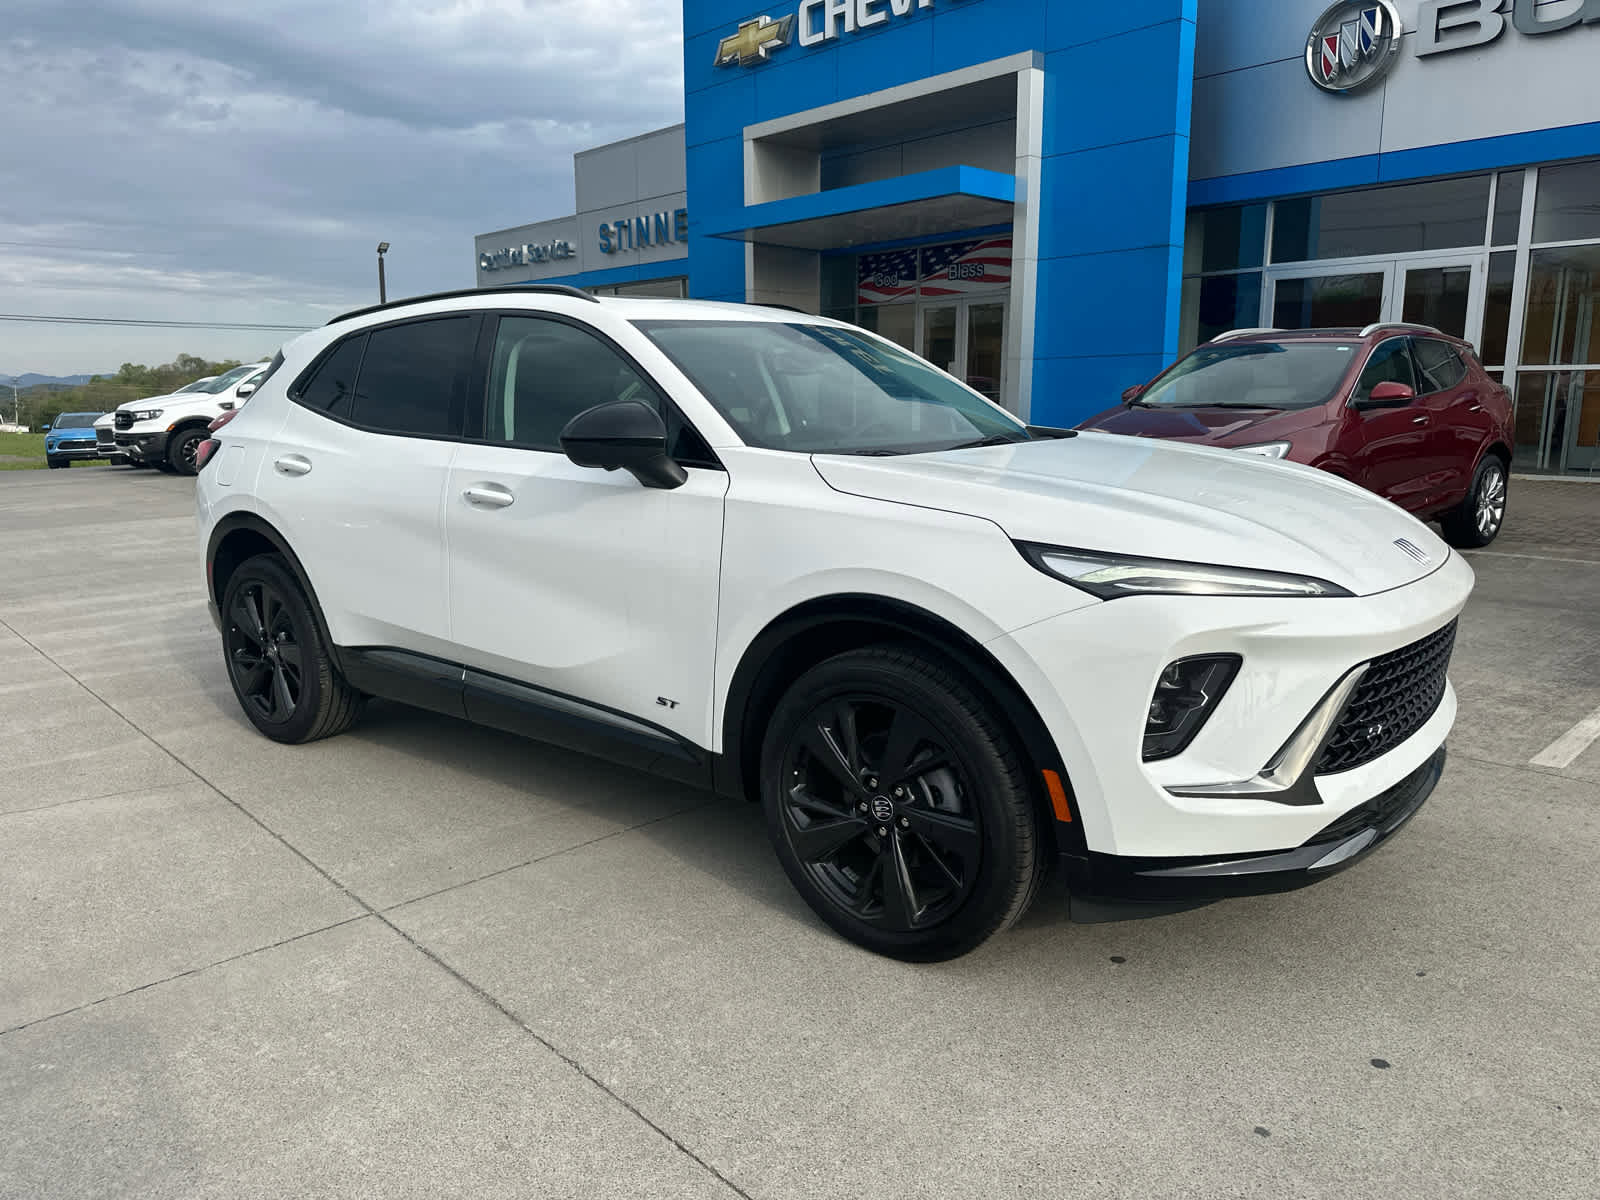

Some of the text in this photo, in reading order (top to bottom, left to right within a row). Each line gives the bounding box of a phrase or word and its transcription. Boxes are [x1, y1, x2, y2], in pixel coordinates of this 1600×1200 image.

[599, 208, 688, 253] STINNE
[875, 264, 984, 287] God Bless
[656, 696, 680, 709] ST
